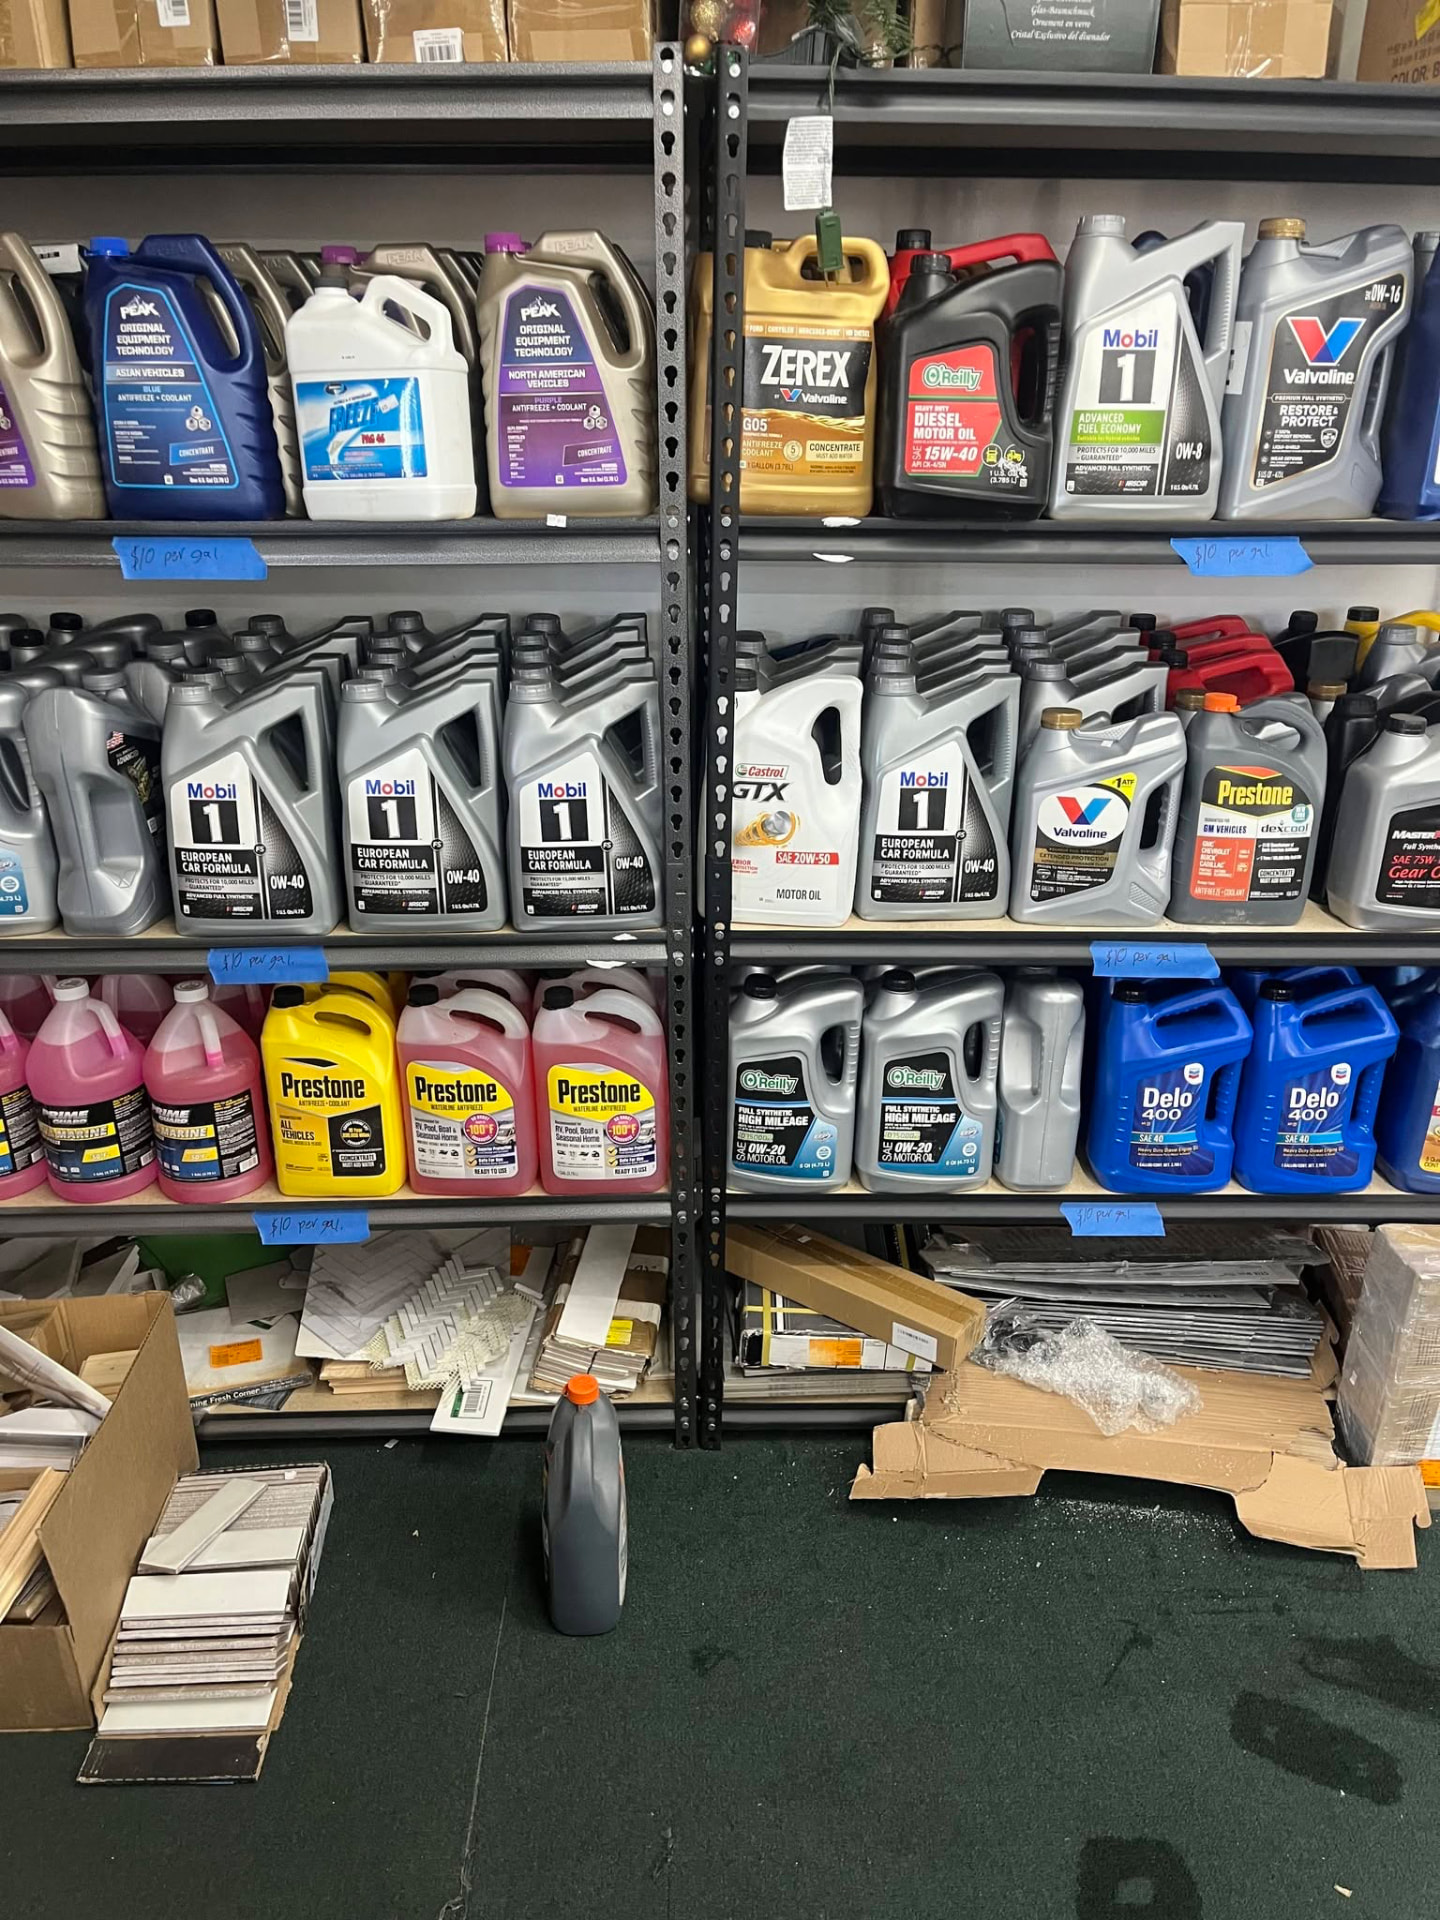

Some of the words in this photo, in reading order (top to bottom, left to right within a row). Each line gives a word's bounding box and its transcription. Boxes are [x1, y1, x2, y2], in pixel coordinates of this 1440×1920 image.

[1371, 283, 1402, 303] 0W-16
[120, 301, 160, 320] PEAK
[520, 303, 561, 321] PEAK
[120, 323, 165, 333] ORIGINAL
[520, 324, 565, 334] ORIGINAL
[116, 335, 171, 345] EQUIPMENT
[516, 336, 570, 346] EQUIPMENT
[1103, 329, 1159, 348] Mobil
[116, 346, 174, 355] TECHNOLOGY
[514, 347, 573, 357] TECHNOLOGY
[116, 368, 141, 377] ASIAN
[142, 368, 185, 377] VEHICLES
[760, 345, 851, 388] ZEREX
[509, 370, 537, 380] NORTH
[538, 369, 586, 379] AMERICAN
[924, 364, 982, 388] O'Reilly
[1117, 353, 1136, 401] 1
[1283, 368, 1355, 385] Valvoline
[527, 379, 569, 388] VEHICLES
[161, 394, 192, 402] COOLANT
[802, 392, 848, 404] Valvoline
[512, 403, 550, 412] ANTIFREEZE
[556, 403, 587, 411] COOLANT
[1279, 404, 1332, 416] RESTORE
[914, 413, 962, 427] DIESEL
[1079, 413, 1124, 423] ADVANCED
[1281, 416, 1334, 427] PROTECT
[742, 418, 768, 431] G05
[1078, 424, 1098, 434] FUEL
[1101, 423, 1142, 434] ECONOMY
[361, 433, 375, 444] PAG
[913, 428, 954, 440] MOTOR
[958, 428, 976, 440] OIL
[578, 446, 612, 457] CONCENTRATE
[809, 443, 860, 452] CONCENTRATE
[924, 446, 978, 461] 15W-40
[1077, 446, 1106, 454] PROTECTS
[1175, 442, 1203, 460] 0W-8
[751, 461, 774, 470] GALLON
[131, 546, 155, 571] $10
[164, 547, 185, 566] per
[1195, 543, 1217, 568] $10
[1228, 546, 1246, 564] per
[748, 766, 785, 777] Castrol
[900, 772, 949, 786] Mobil
[187, 783, 237, 799] Mobil
[366, 780, 415, 795] Mobil
[538, 782, 586, 797] Mobil
[732, 781, 792, 803] GTX
[1217, 780, 1293, 805] Prestone
[913, 790, 929, 829] 1
[203, 803, 223, 842] 1
[381, 799, 401, 838] 1
[553, 802, 572, 840] 1
[1053, 827, 1107, 839] Valvoline
[1204, 824, 1214, 833] GM
[1216, 824, 1247, 834] VEHICLES
[1261, 823, 1308, 833] dexcool
[881, 838, 934, 848] EUROPEAN
[181, 852, 232, 862] EUROPEAN
[357, 848, 410, 859] EUROPEAN
[528, 850, 575, 860] EUROPEAN
[778, 852, 793, 863] SAE
[794, 852, 831, 864] 20W-50
[881, 848, 900, 859] CAR
[903, 849, 950, 859] FORMULA
[1039, 852, 1071, 860] EXTENDED
[1392, 855, 1412, 864] SAE
[182, 862, 200, 873] CAR
[203, 863, 251, 874] FORMULA
[358, 858, 377, 869] CAR
[379, 859, 428, 869] FORMULA
[529, 860, 546, 870] CAR
[548, 860, 592, 870] FORMULA
[615, 856, 644, 870] 0W-40
[964, 859, 995, 873] 0W-40
[447, 869, 480, 884] 0W-40
[1388, 866, 1427, 879] Gear
[270, 875, 305, 889] 0W-40
[776, 888, 807, 900] MOTOR
[808, 889, 822, 900] OIL
[249, 954, 267, 968] per
[1104, 947, 1128, 968] $10
[1132, 951, 1152, 967] per
[743, 1070, 797, 1092] O'Reilly
[891, 1068, 944, 1088] O'Reilly
[281, 1072, 365, 1099] Prestone
[415, 1076, 497, 1103] Prestone
[558, 1079, 641, 1104] Prestone
[1143, 1087, 1193, 1108] Delo
[1289, 1087, 1339, 1108] Delo
[42, 1108, 89, 1120] PRIME
[739, 1107, 754, 1115] FULL
[1142, 1109, 1181, 1120] 400
[1288, 1109, 1328, 1121] 400
[739, 1114, 762, 1126] HIGH
[765, 1116, 809, 1126] MILEAGE
[884, 1113, 909, 1123] HIGH
[911, 1113, 956, 1123] MILEAGE
[280, 1120, 292, 1130] ALL
[281, 1129, 315, 1141] VEHICLES
[555, 1134, 582, 1143] Seasonal
[1140, 1134, 1152, 1143] SAE
[1153, 1134, 1164, 1142] 40
[1285, 1135, 1298, 1143] SAE
[1299, 1135, 1309, 1143] 40
[736, 1142, 746, 1161] SAE
[748, 1143, 785, 1155] 0W-20
[882, 1142, 892, 1161] SAE
[895, 1142, 932, 1152] 0W-20
[747, 1154, 775, 1164] MOTOR
[776, 1155, 788, 1164] OIL
[893, 1153, 922, 1162] MOTOR
[922, 1154, 934, 1162] OIL
[1096, 1209, 1113, 1222] per
[270, 1216, 291, 1237] $10
[298, 1218, 318, 1234] per
[209, 1394, 232, 1404] Fresh
[233, 1388, 260, 1398] Corner
